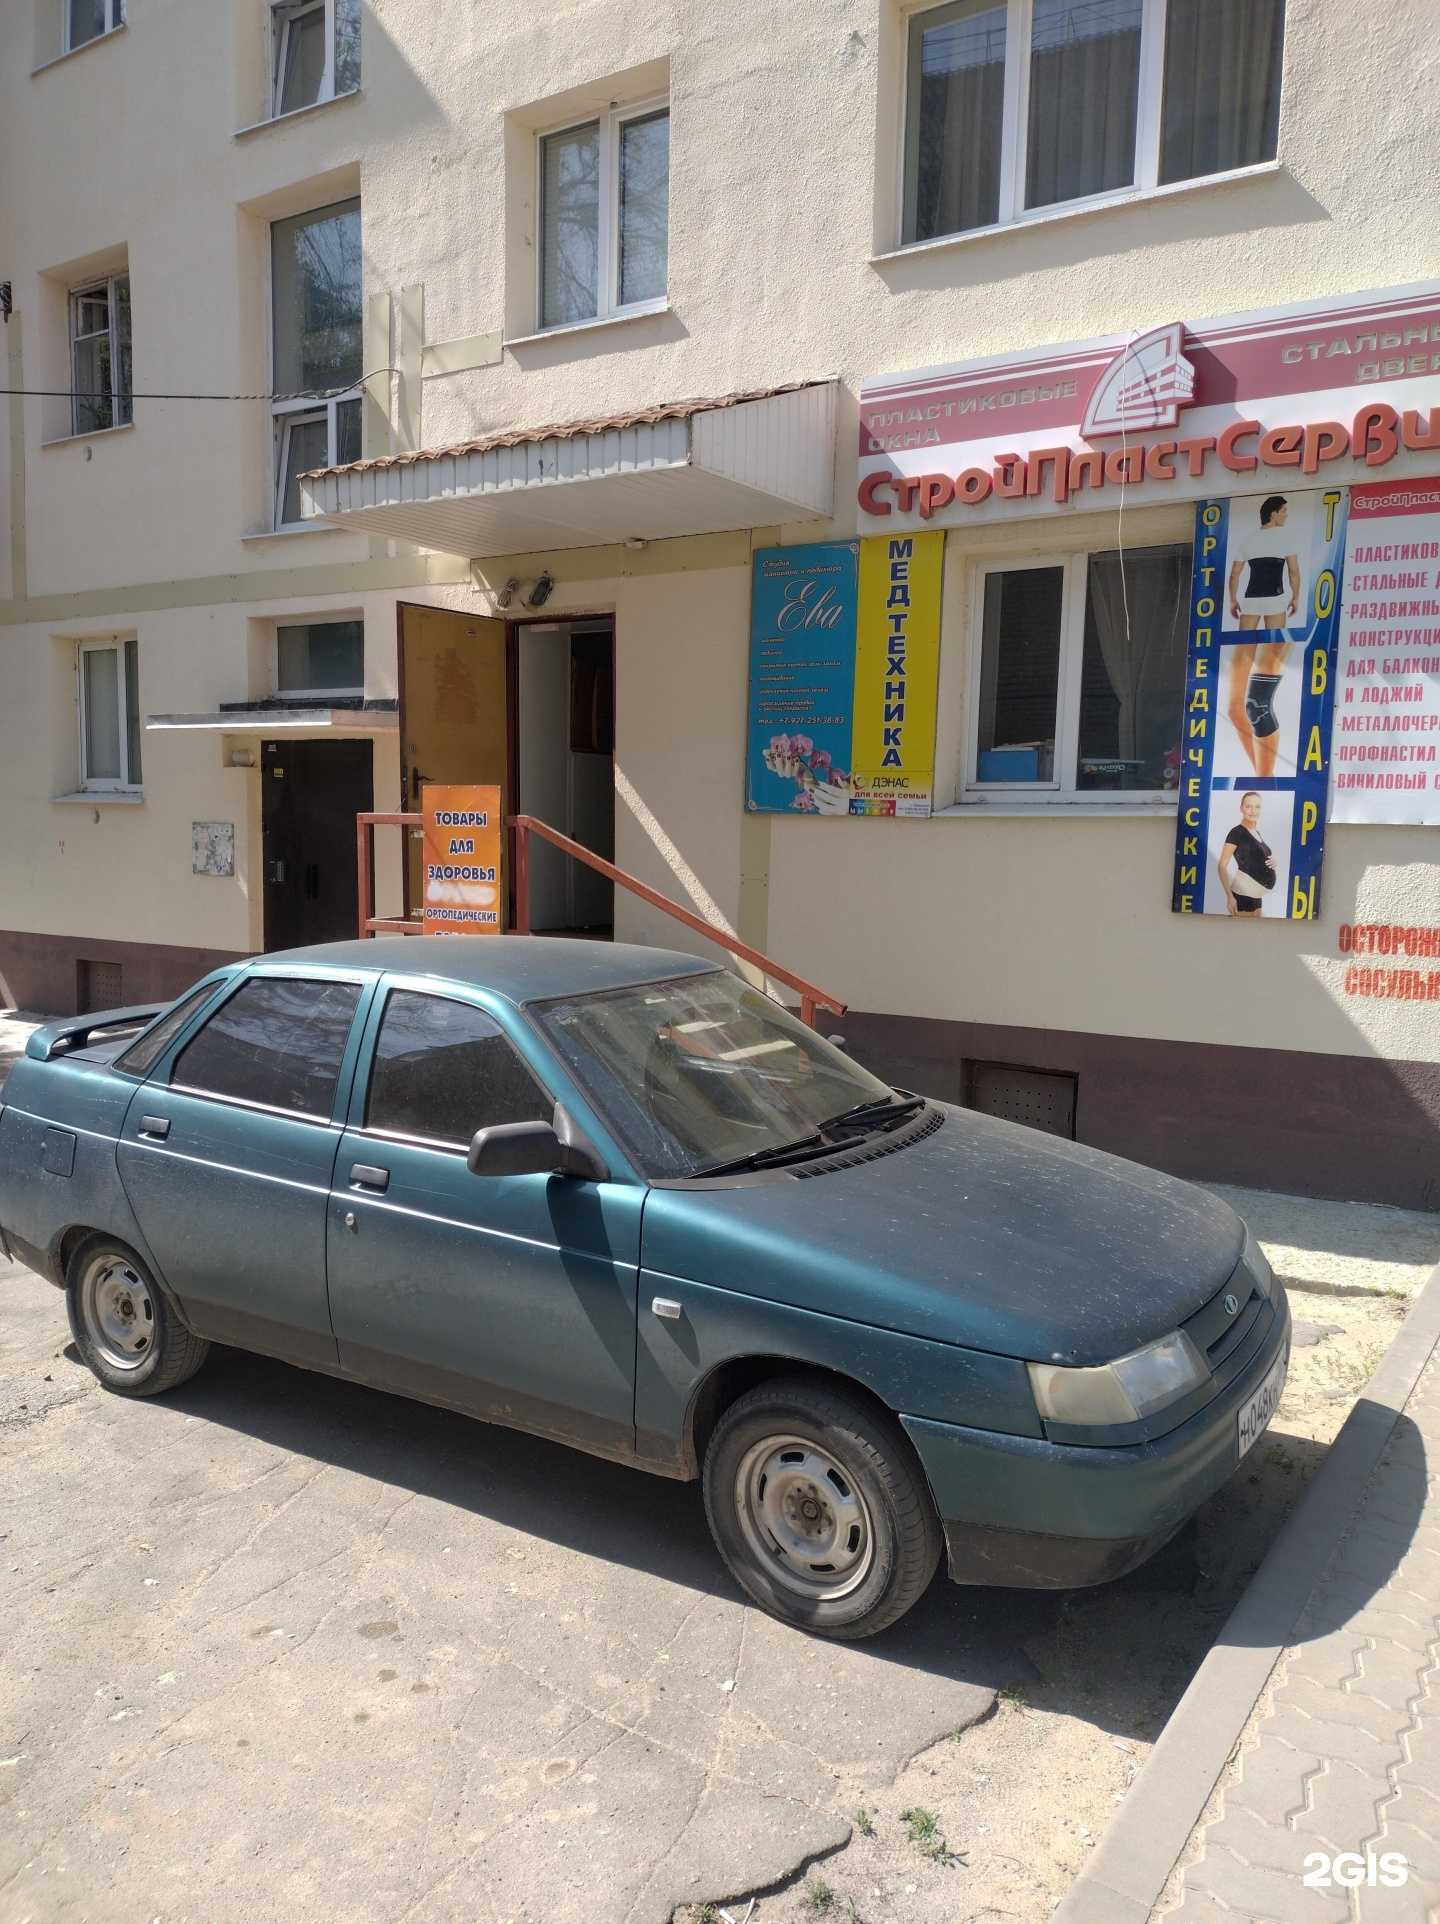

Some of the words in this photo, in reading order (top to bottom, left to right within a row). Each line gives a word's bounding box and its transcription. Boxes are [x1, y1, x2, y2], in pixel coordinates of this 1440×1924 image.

[1280, 321, 1440, 365] СТАЛЬН
[869, 378, 1079, 427] ПЛАСТИКОВЫЕ
[868, 427, 941, 453] ОКНА
[881, 538, 914, 768] МЕДТЕХНИКА
[1346, 658, 1376, 678] ДЛЯ
[1382, 656, 1440, 674] БАЛКОН
[1344, 687, 1354, 704] И
[1360, 683, 1424, 705] ЛОДЖИЙ
[1180, 503, 1221, 914] ОРТОПЕДИЧЕСКИЕ
[1291, 491, 1342, 921] ТОВАРЫ
[1338, 715, 1440, 732] -МЕТАЛЛОЧЕР
[872, 777, 910, 789] ДЭНАС
[435, 811, 488, 826] ТОВАРЫ
[449, 838, 474, 855] ДЛЯ
[428, 865, 496, 881] ЗДОРОВЬЯ
[426, 907, 497, 923] ОРТОПЕДИЧЕСКИЕ
